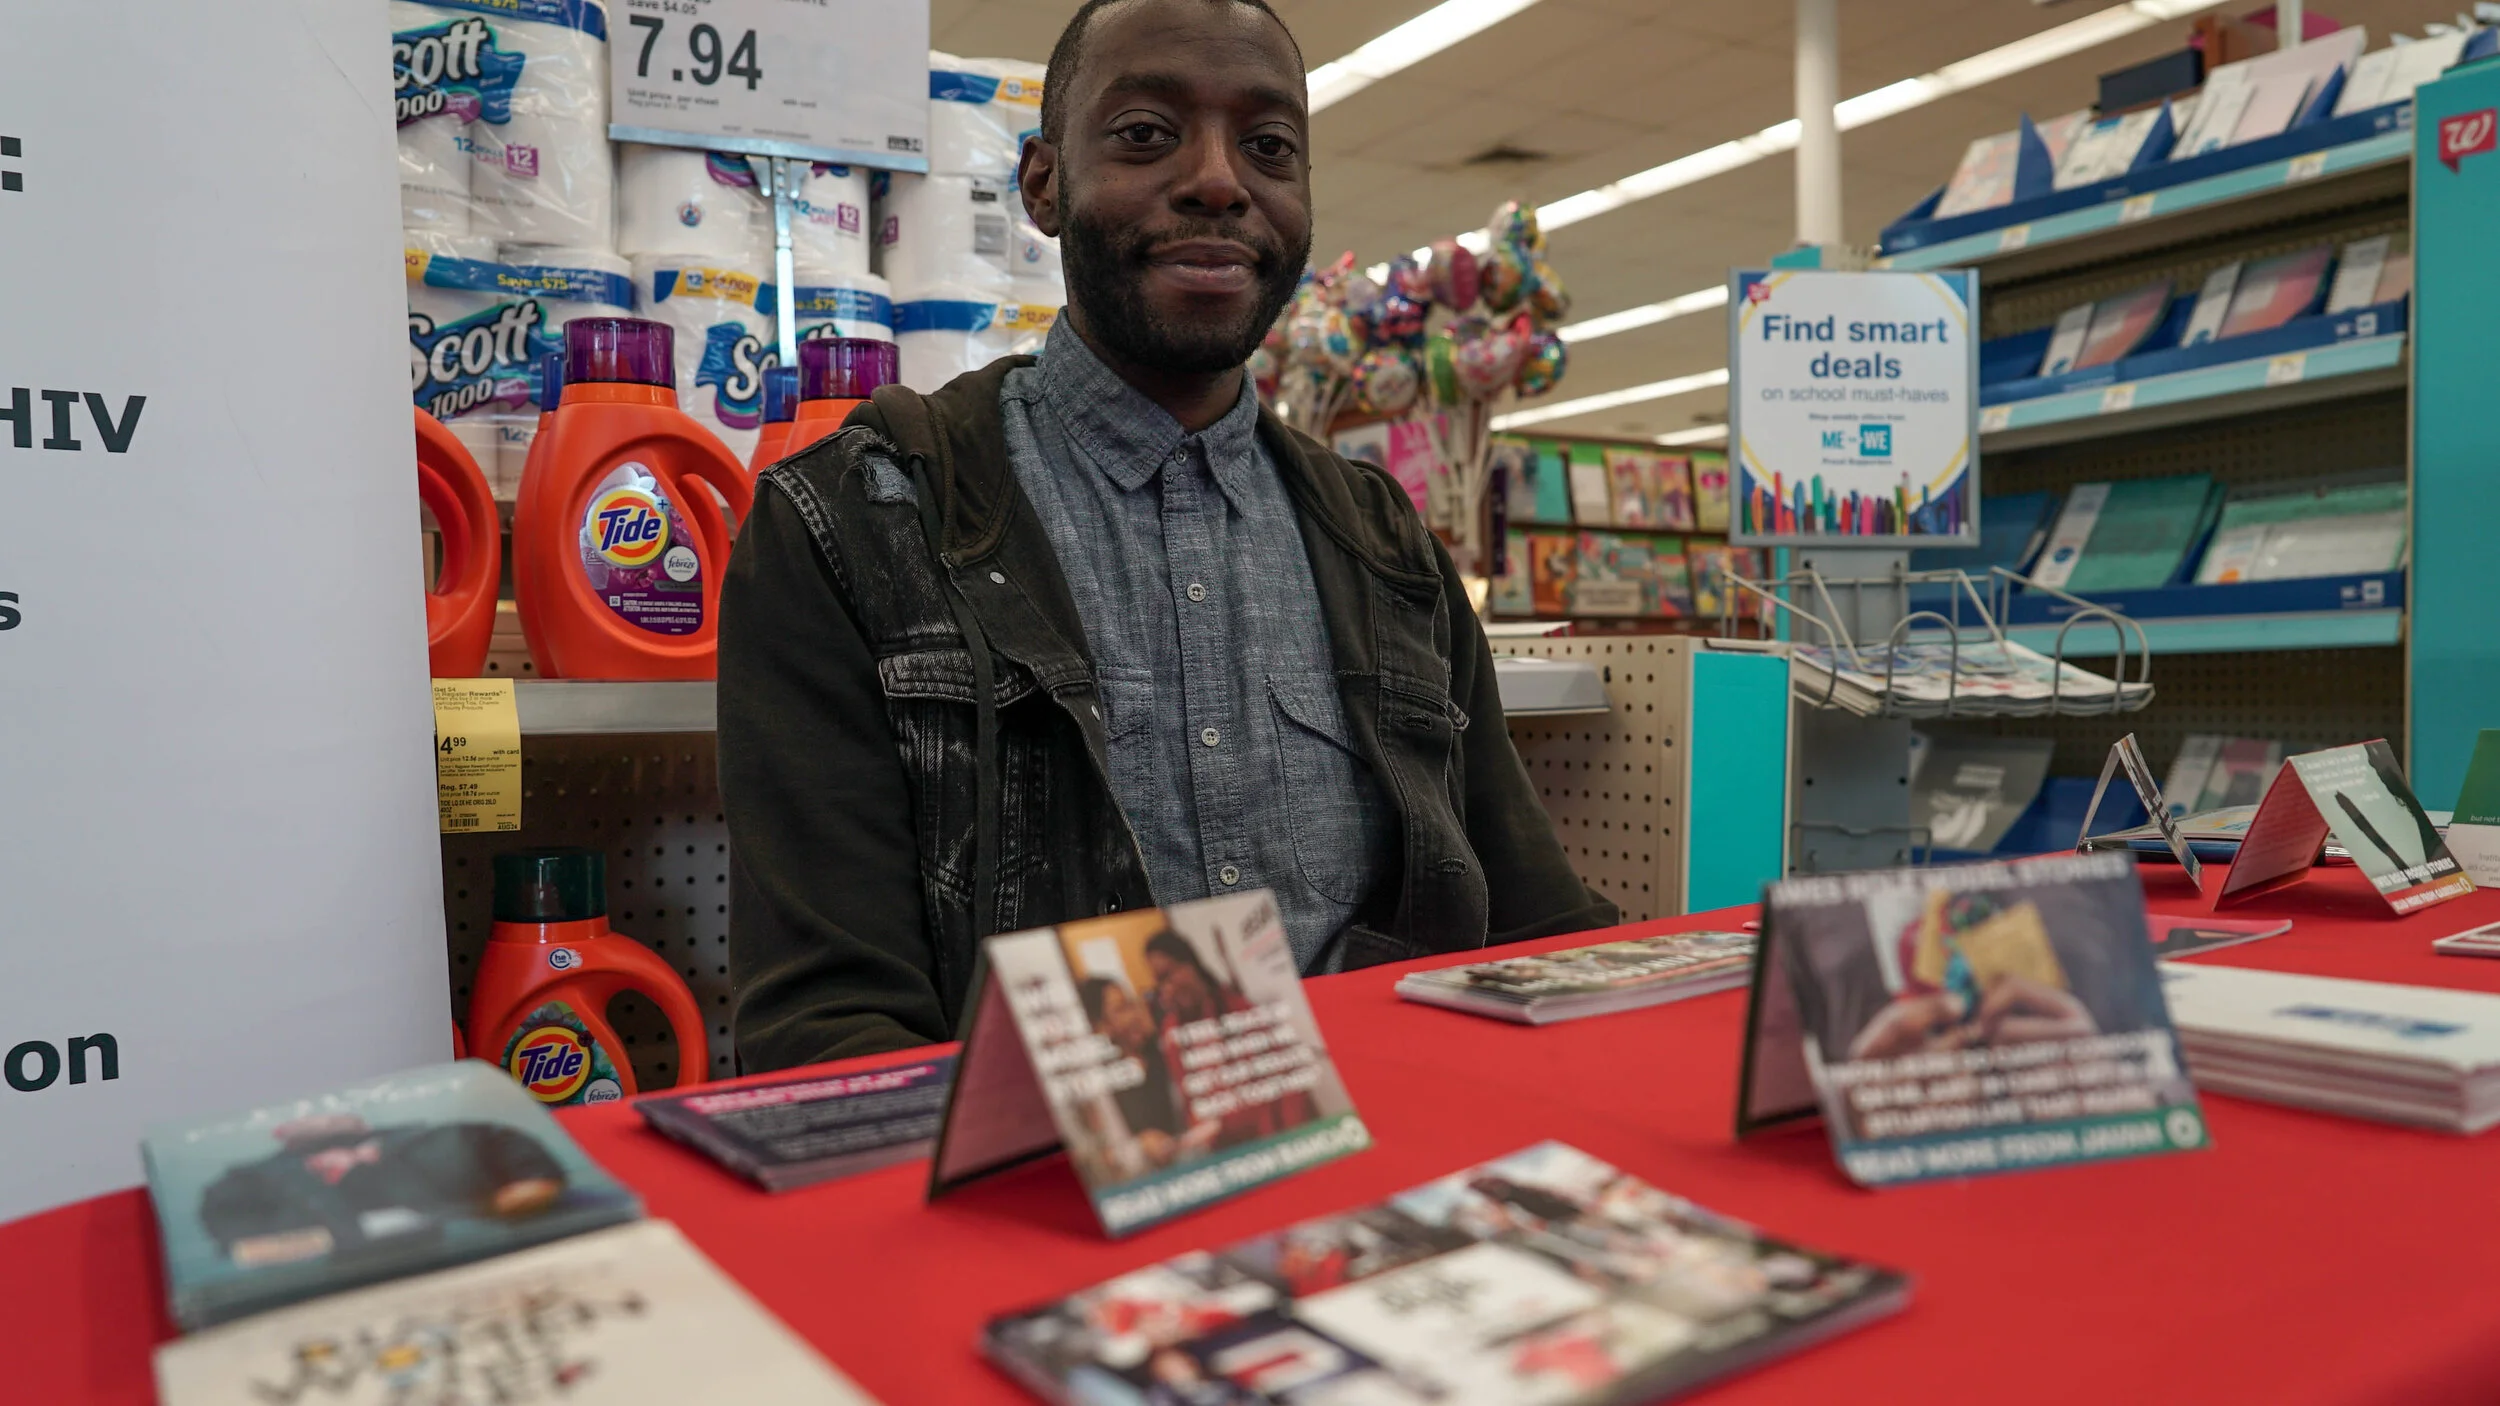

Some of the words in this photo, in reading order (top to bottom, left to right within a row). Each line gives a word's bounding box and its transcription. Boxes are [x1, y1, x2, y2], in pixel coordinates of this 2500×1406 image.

[663, 2, 698, 15] $4.05
[630, 14, 762, 91] 7.94
[453, 137, 474, 153] 12
[511, 149, 533, 167] 12
[497, 274, 533, 287] Save
[541, 278, 568, 290] $75
[1763, 314, 1834, 342] Find
[1848, 317, 1948, 343] smart
[409, 300, 540, 393] Scott
[1810, 351, 1902, 379] deals
[431, 378, 493, 420] 1000
[1761, 388, 1783, 400] on
[1789, 385, 1846, 401] school
[1852, 386, 1949, 403] must-haves
[0, 387, 147, 454] HIV
[1822, 430, 1845, 449] ME
[1864, 430, 1888, 450] WE
[597, 508, 662, 552] Tide
[668, 555, 695, 569] febreze
[2470, 814, 2482, 822] but
[2426, 857, 2455, 874] STORIES
[4, 1032, 119, 1092] on
[519, 1044, 584, 1089] Tide
[1922, 1139, 1997, 1171] MORE
[2002, 1132, 2075, 1160] FROM
